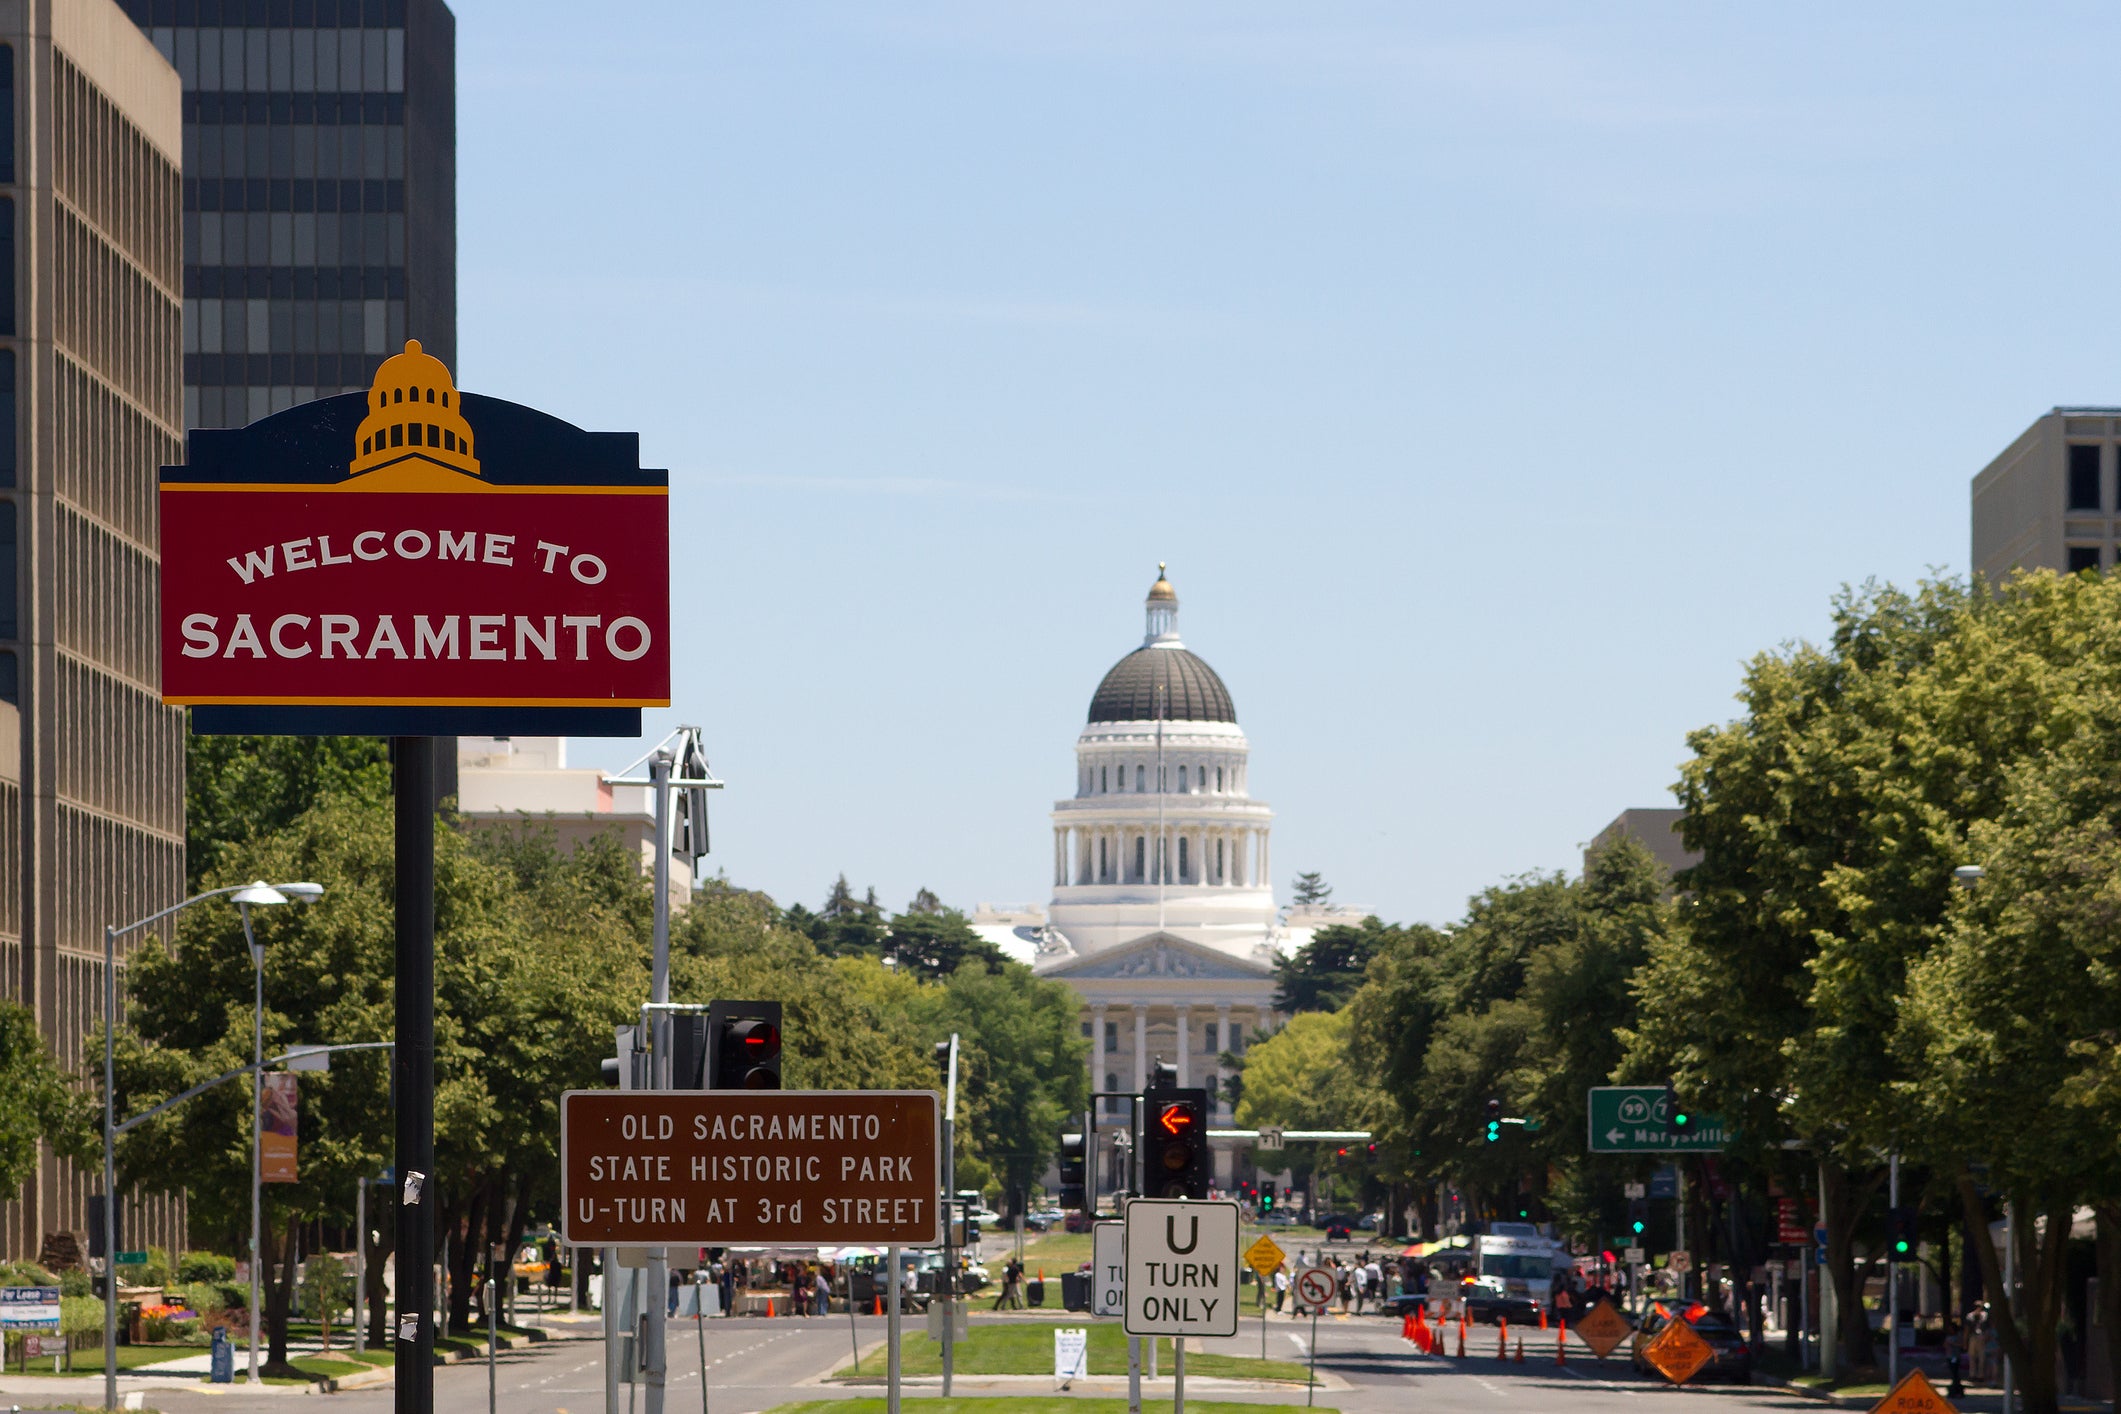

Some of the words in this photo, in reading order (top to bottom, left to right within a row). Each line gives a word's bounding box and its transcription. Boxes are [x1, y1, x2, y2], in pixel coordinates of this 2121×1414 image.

[227, 529, 516, 585] WELCOME
[537, 539, 607, 585] TO
[181, 613, 652, 662] SACRAMENTO
[1624, 1103, 1645, 1116] 99
[622, 1115, 674, 1140] OLD
[693, 1114, 880, 1140] SACRAMENTO
[589, 1155, 671, 1181] STATE
[691, 1155, 821, 1181] HISTORIC
[841, 1156, 914, 1182] PARK
[579, 1198, 687, 1223] U-TURN
[707, 1198, 738, 1223] AT
[757, 1198, 802, 1224] 3rd
[822, 1198, 924, 1224] STREET
[1166, 1215, 1199, 1256] U
[1145, 1262, 1219, 1288] TURN
[1142, 1296, 1219, 1323] ONLY
[1897, 1397, 1935, 1411] ROAD
